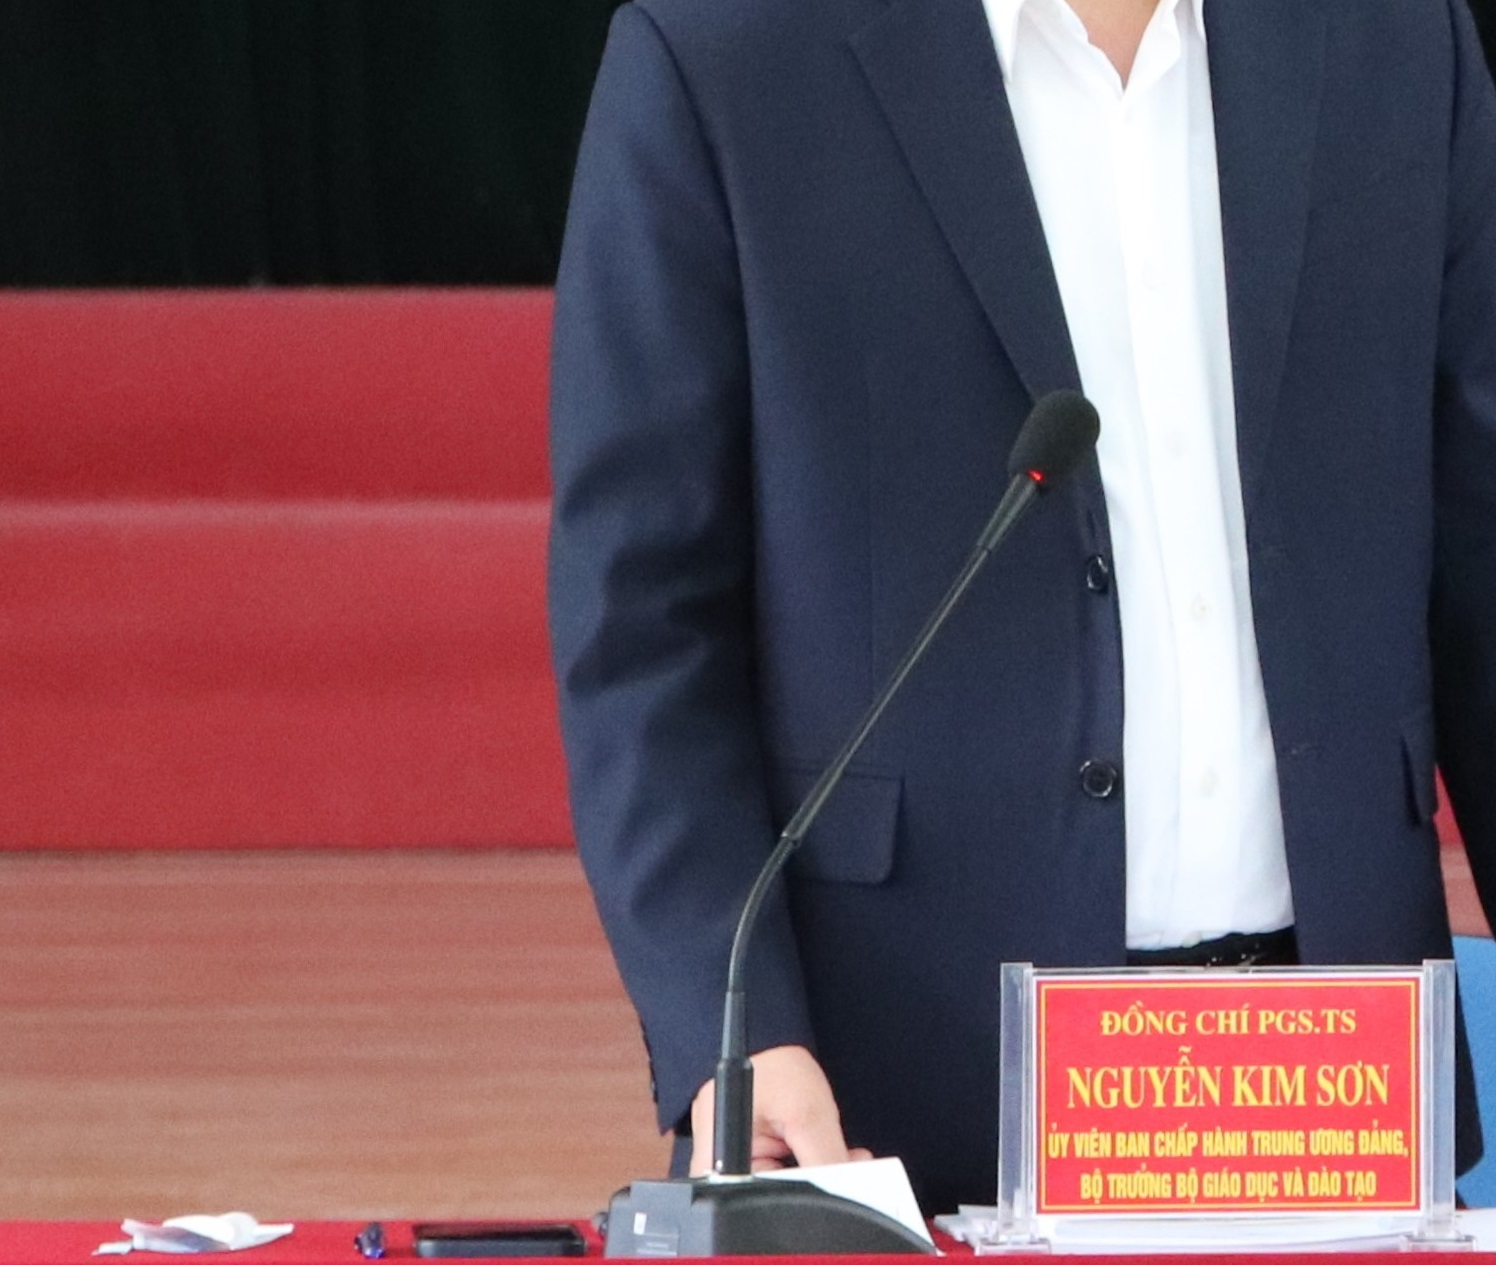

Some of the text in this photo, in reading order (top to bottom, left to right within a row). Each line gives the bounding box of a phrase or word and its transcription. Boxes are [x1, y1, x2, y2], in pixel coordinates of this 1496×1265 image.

[1101, 1000, 1356, 1035] ĐỒNG CHÍ PGS.TS
[1067, 1046, 1389, 1108] NGUYỄN KIM SƠN
[1048, 1119, 1409, 1158] ỦY VIÊN BAN CHẤP HÀNH TRUNG ƯƠNG ĐẢNG,
[1080, 1162, 1376, 1204] BỘ TRƯỞNG BỘ GIÁO DỤC VÀ ĐÀO TẠO
